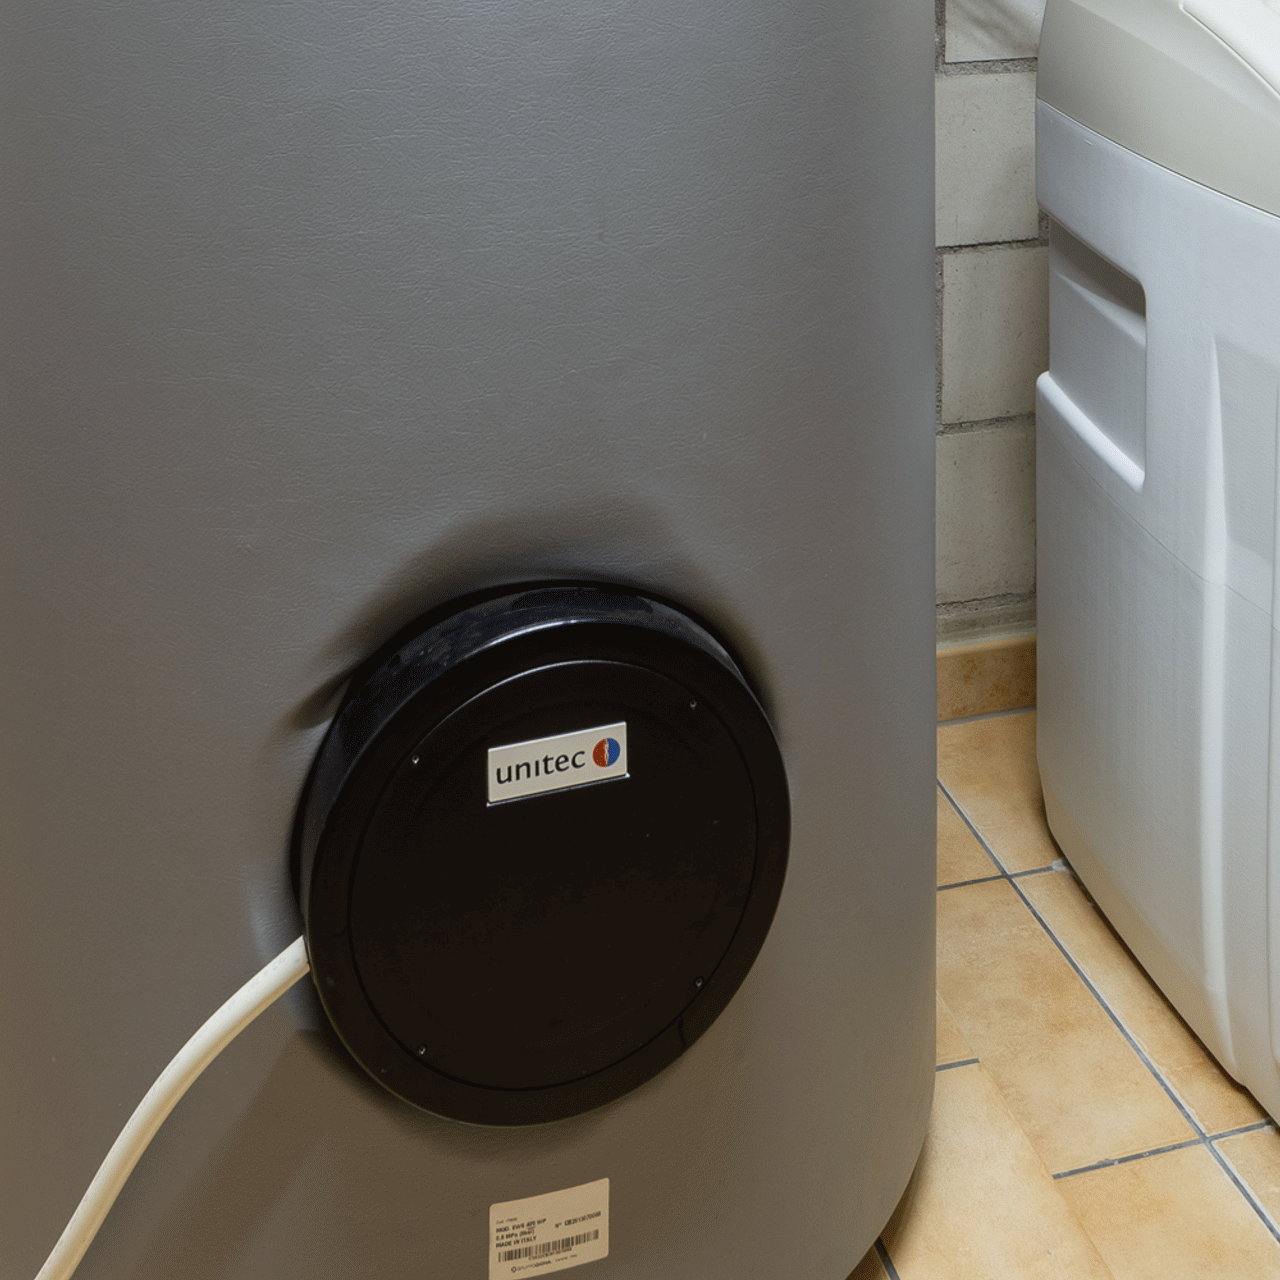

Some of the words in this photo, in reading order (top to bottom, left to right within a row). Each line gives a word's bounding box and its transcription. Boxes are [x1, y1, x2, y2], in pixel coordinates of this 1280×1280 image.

[496, 750, 587, 785] unitec
[495, 1240, 512, 1249] MADE
[521, 1235, 537, 1244] ITALY
